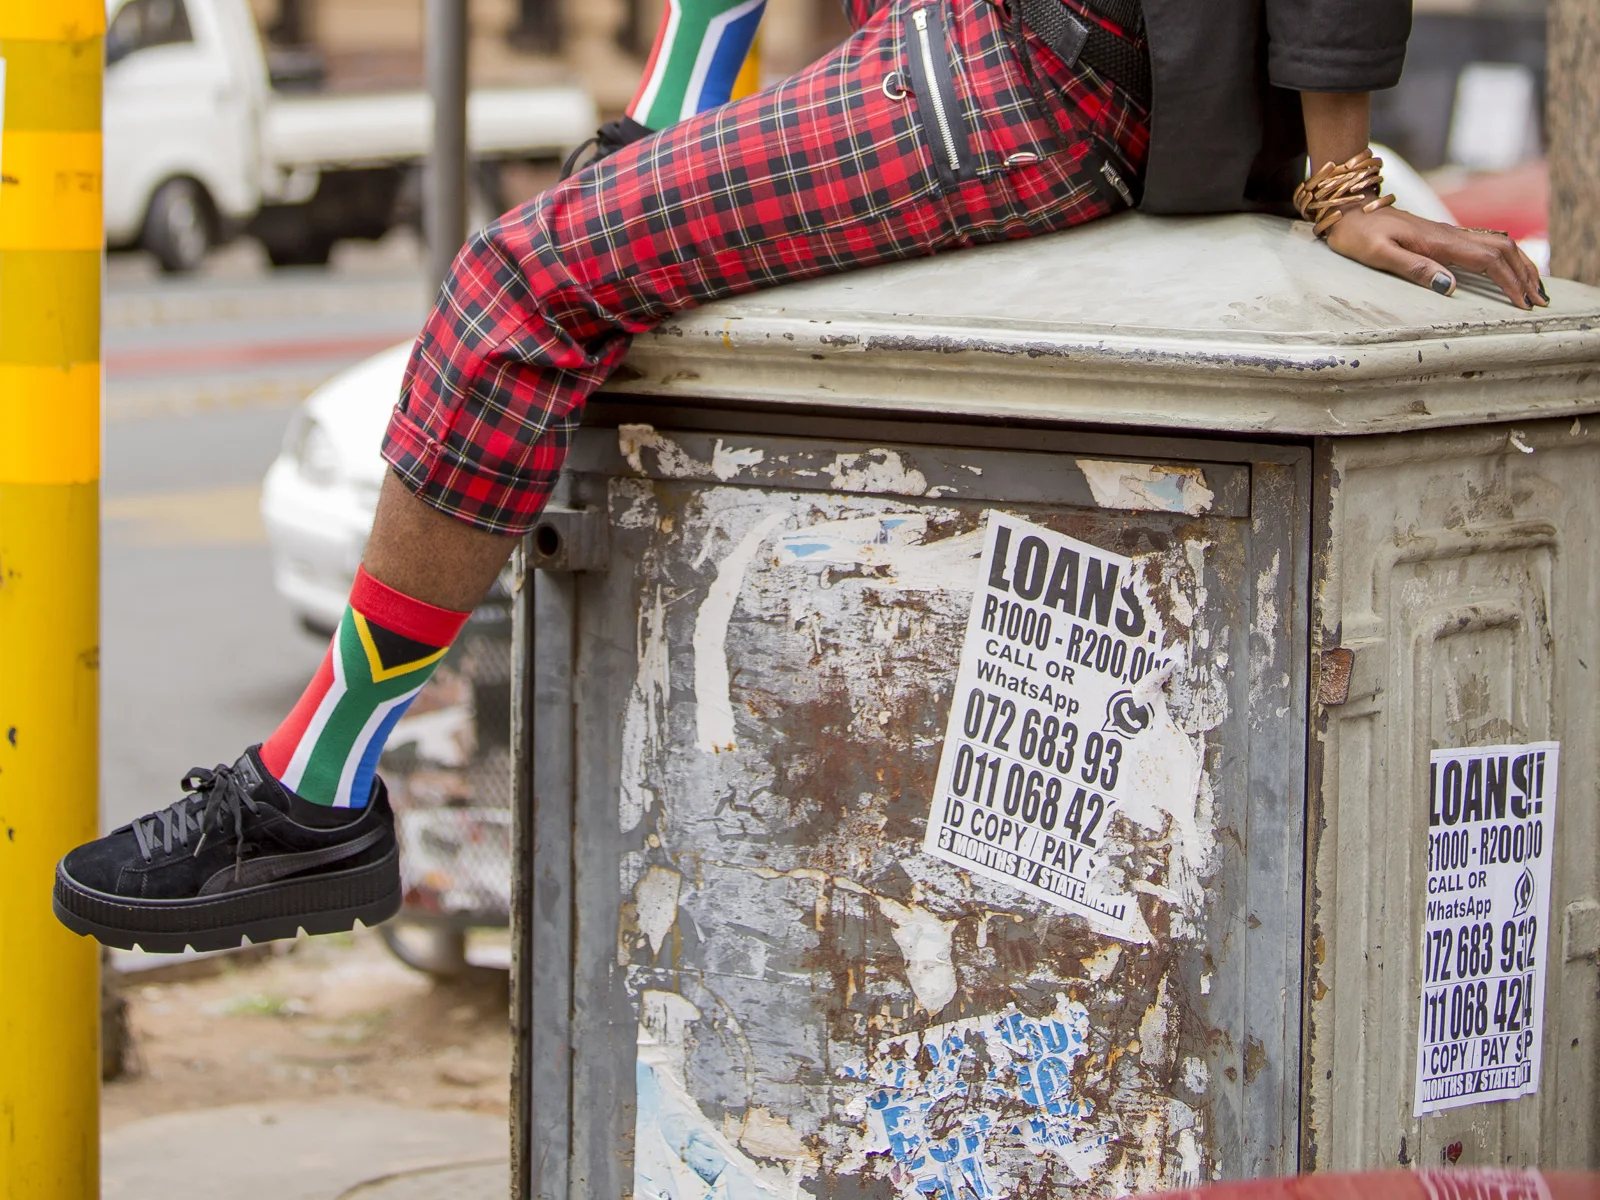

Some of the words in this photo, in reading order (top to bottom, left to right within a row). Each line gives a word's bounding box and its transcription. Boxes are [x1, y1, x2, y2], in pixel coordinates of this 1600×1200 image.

[987, 525, 1157, 645] LOANS
[981, 593, 1052, 651] R1000
[977, 658, 1080, 718] WhatsApp
[985, 638, 1038, 672] CALL
[1045, 660, 1076, 685] OR
[963, 687, 1017, 752] 072
[1019, 708, 1079, 775] 683
[952, 743, 1002, 809] 011
[1003, 762, 1063, 831] 068
[1063, 787, 1117, 849] 42
[939, 829, 953, 850] 3
[952, 832, 1018, 876] MONTHS
[942, 796, 965, 828] ID
[970, 808, 1028, 852] COPY
[1041, 834, 1084, 874] PAY
[1428, 873, 1464, 895] CALL
[1468, 870, 1487, 889] OR
[1456, 921, 1494, 979] 683
[1450, 980, 1488, 1040] 068
[1430, 1041, 1468, 1075] COPY
[1480, 1035, 1510, 1067] PAY
